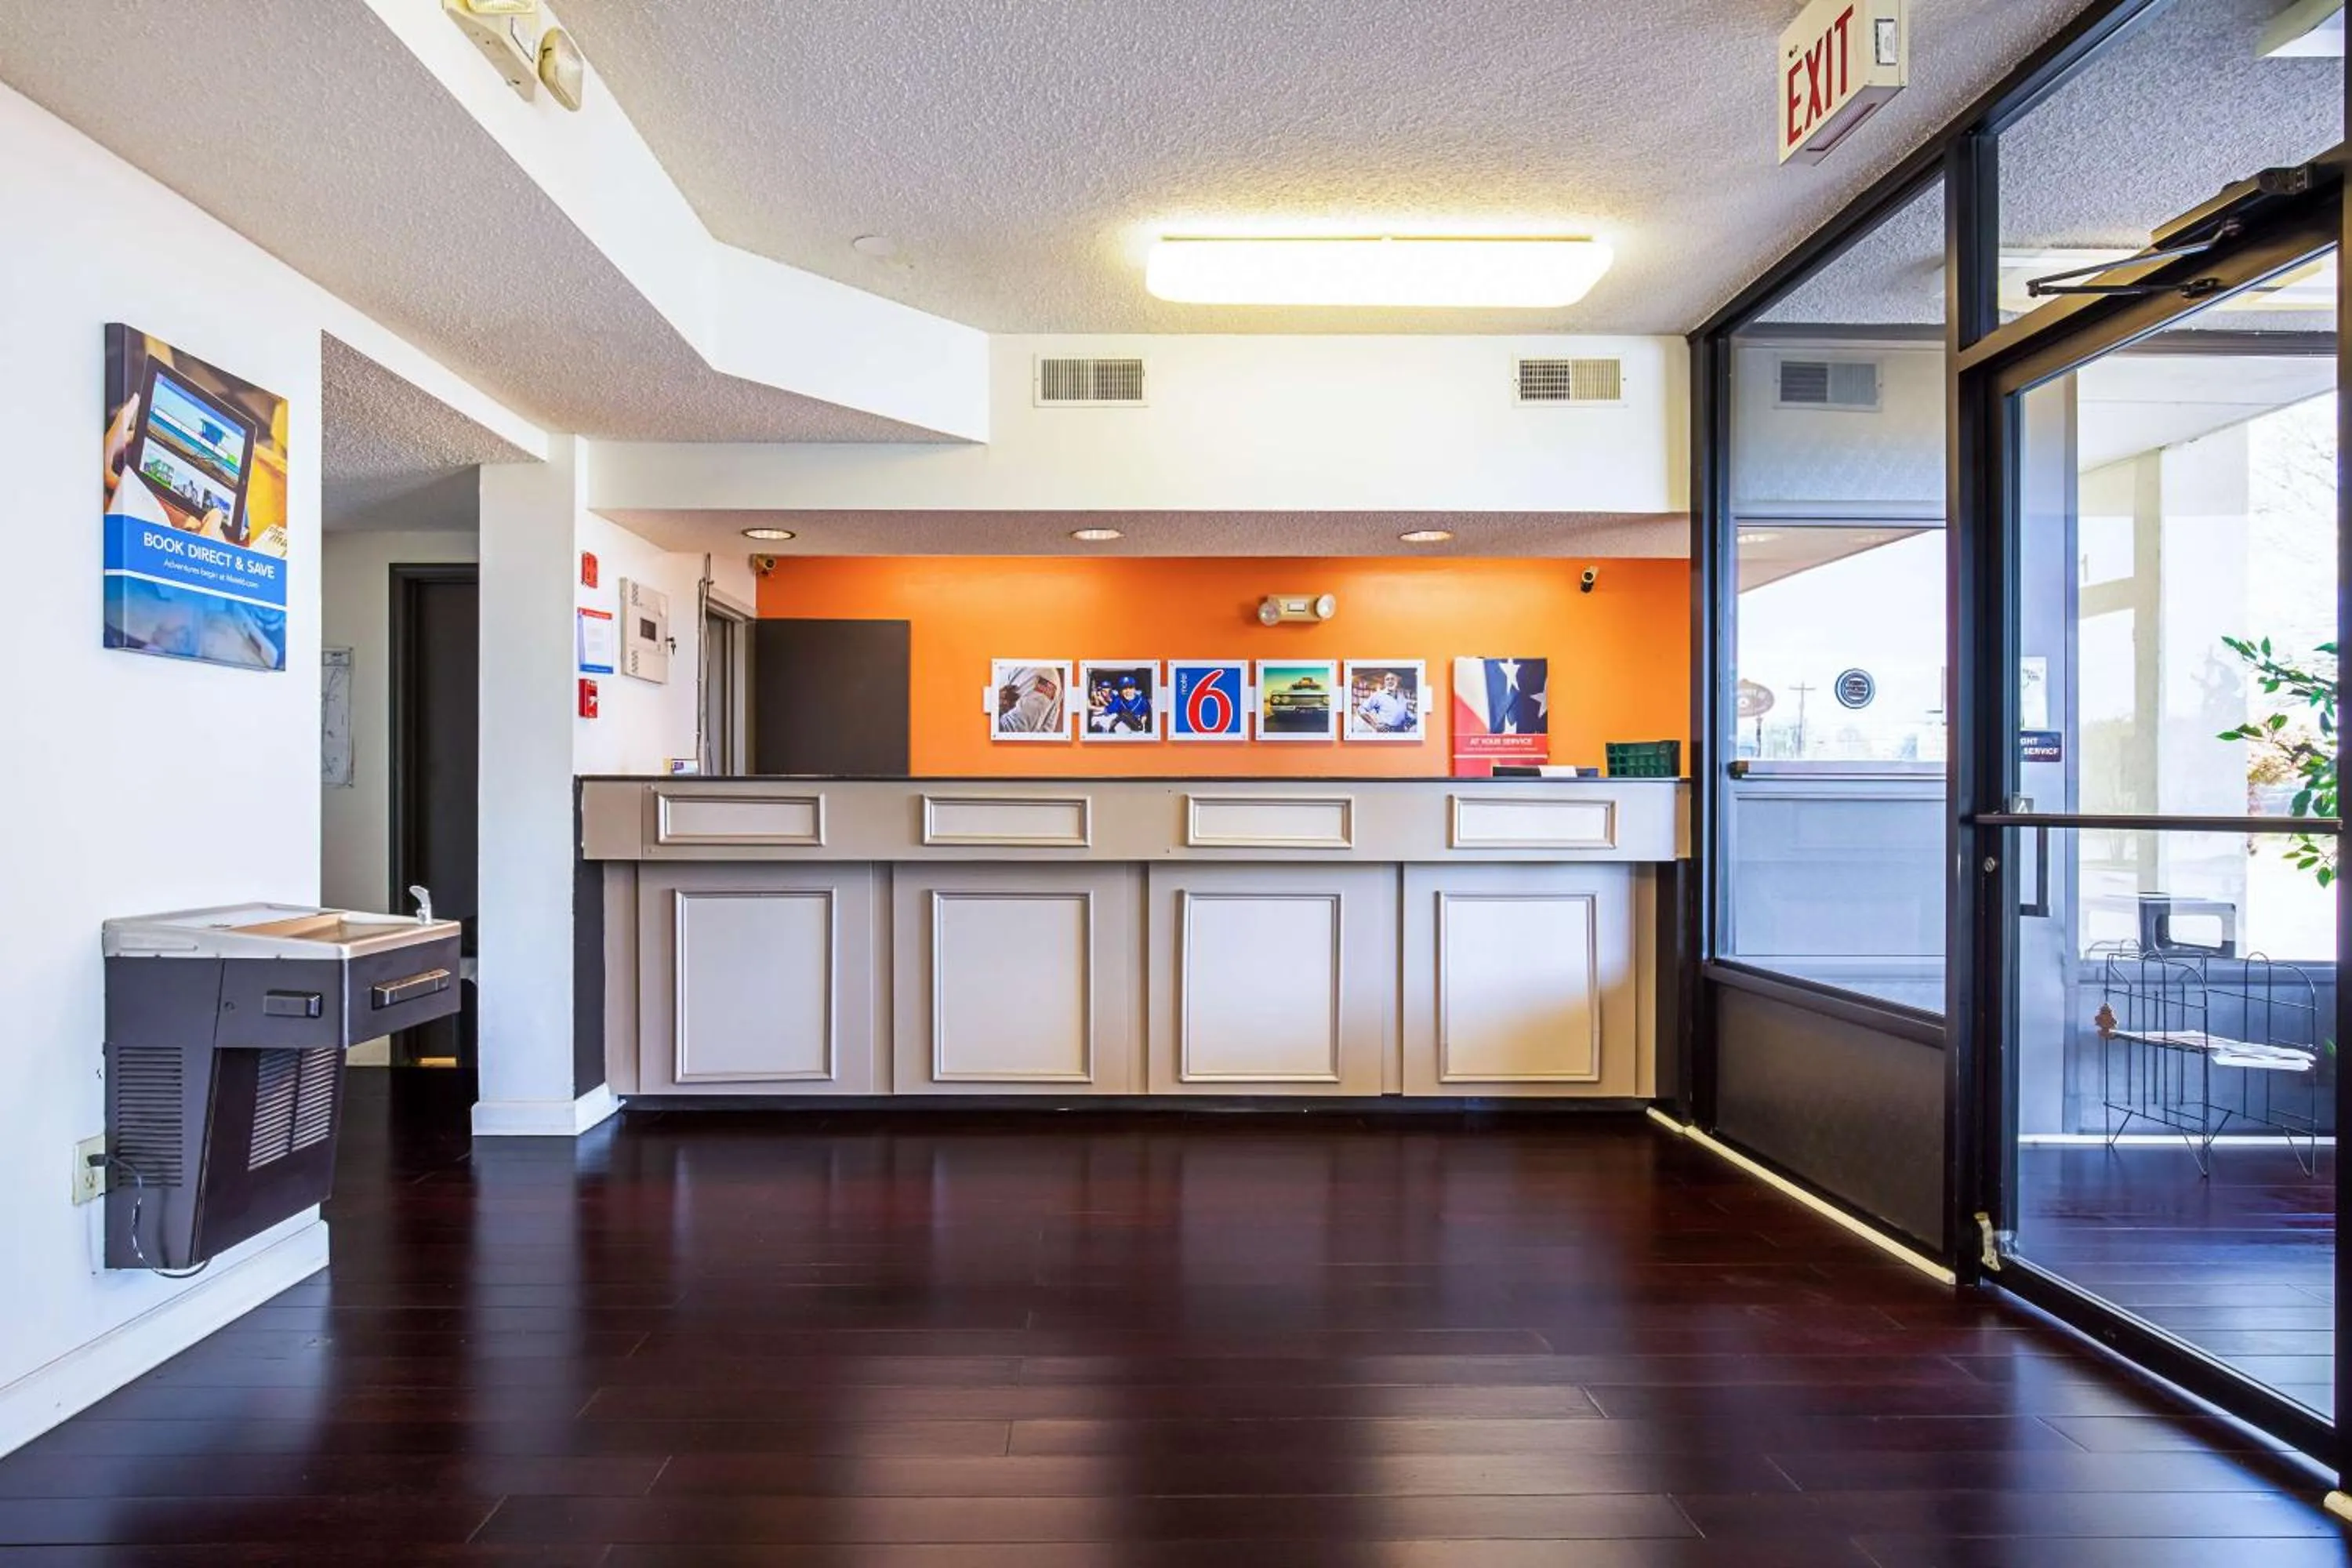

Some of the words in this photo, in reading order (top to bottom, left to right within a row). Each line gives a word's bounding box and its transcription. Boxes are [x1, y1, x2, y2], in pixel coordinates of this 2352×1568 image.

[1787, 4, 1854, 147] EXIT
[143, 532, 184, 556] BOOK
[187, 543, 232, 568] DIRECT
[235, 556, 245, 572] &
[247, 560, 275, 579] SAVE
[1186, 669, 1233, 735] 6
